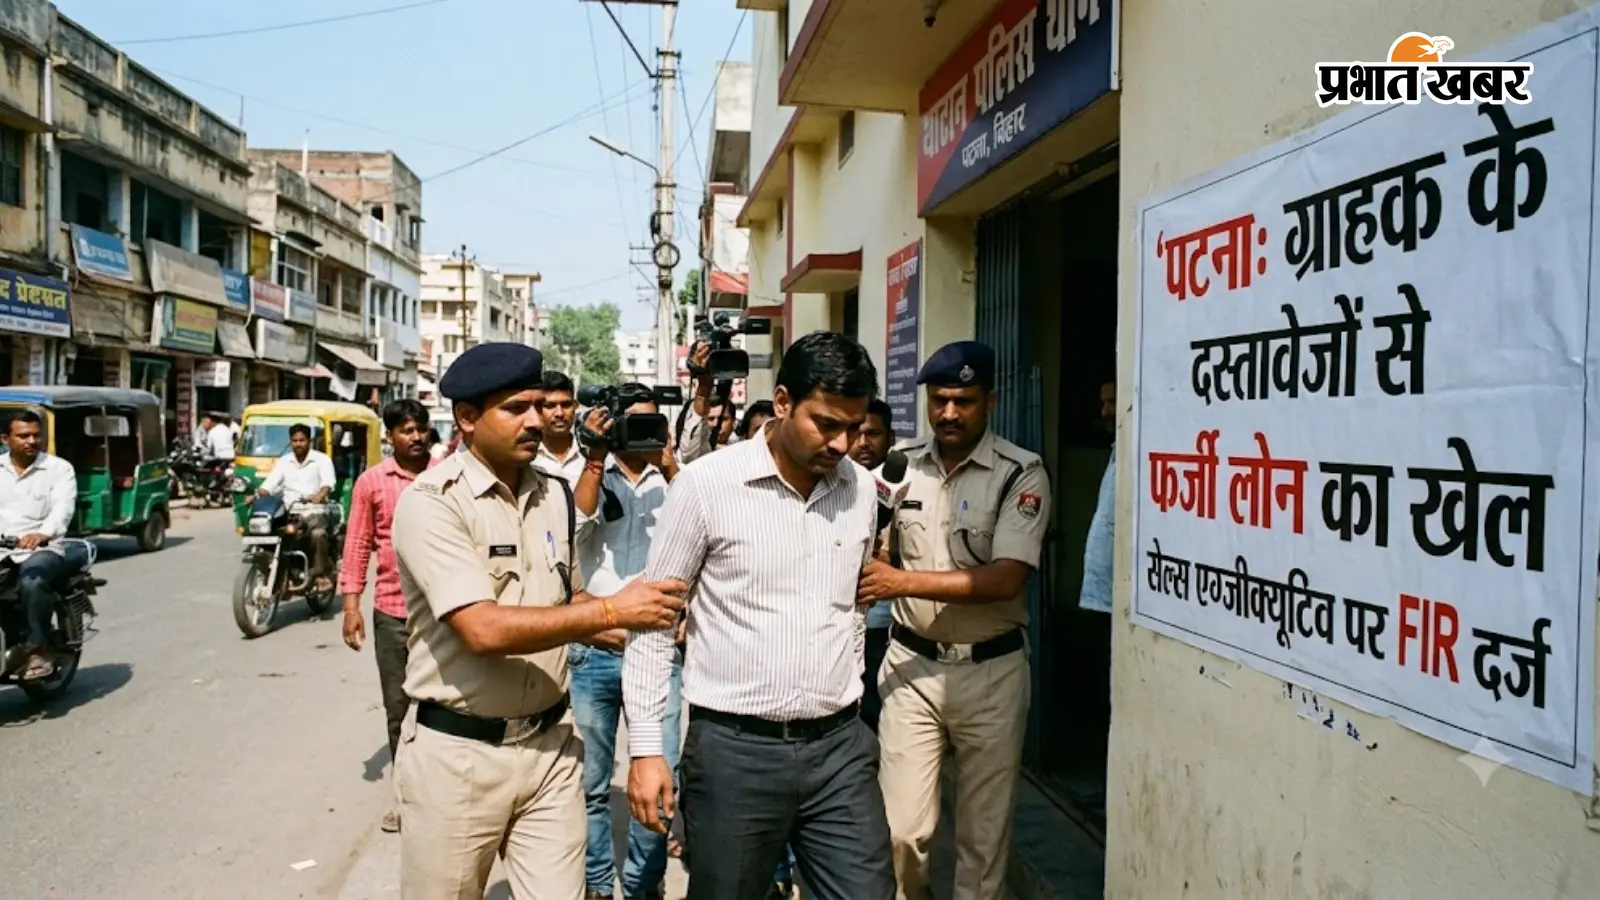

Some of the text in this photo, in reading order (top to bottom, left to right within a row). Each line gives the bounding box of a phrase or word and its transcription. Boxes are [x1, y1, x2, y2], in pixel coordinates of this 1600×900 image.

[1282, 151, 1447, 281] ग्राहक
[1462, 102, 1555, 233] के
[1190, 283, 1432, 406] दस्तावेजों से
[1149, 429, 1556, 573] फर्जी लोन का खेल
[1146, 537, 1553, 709] सेल्स एग्जीक्यूटिव पर FIR दर्ज
